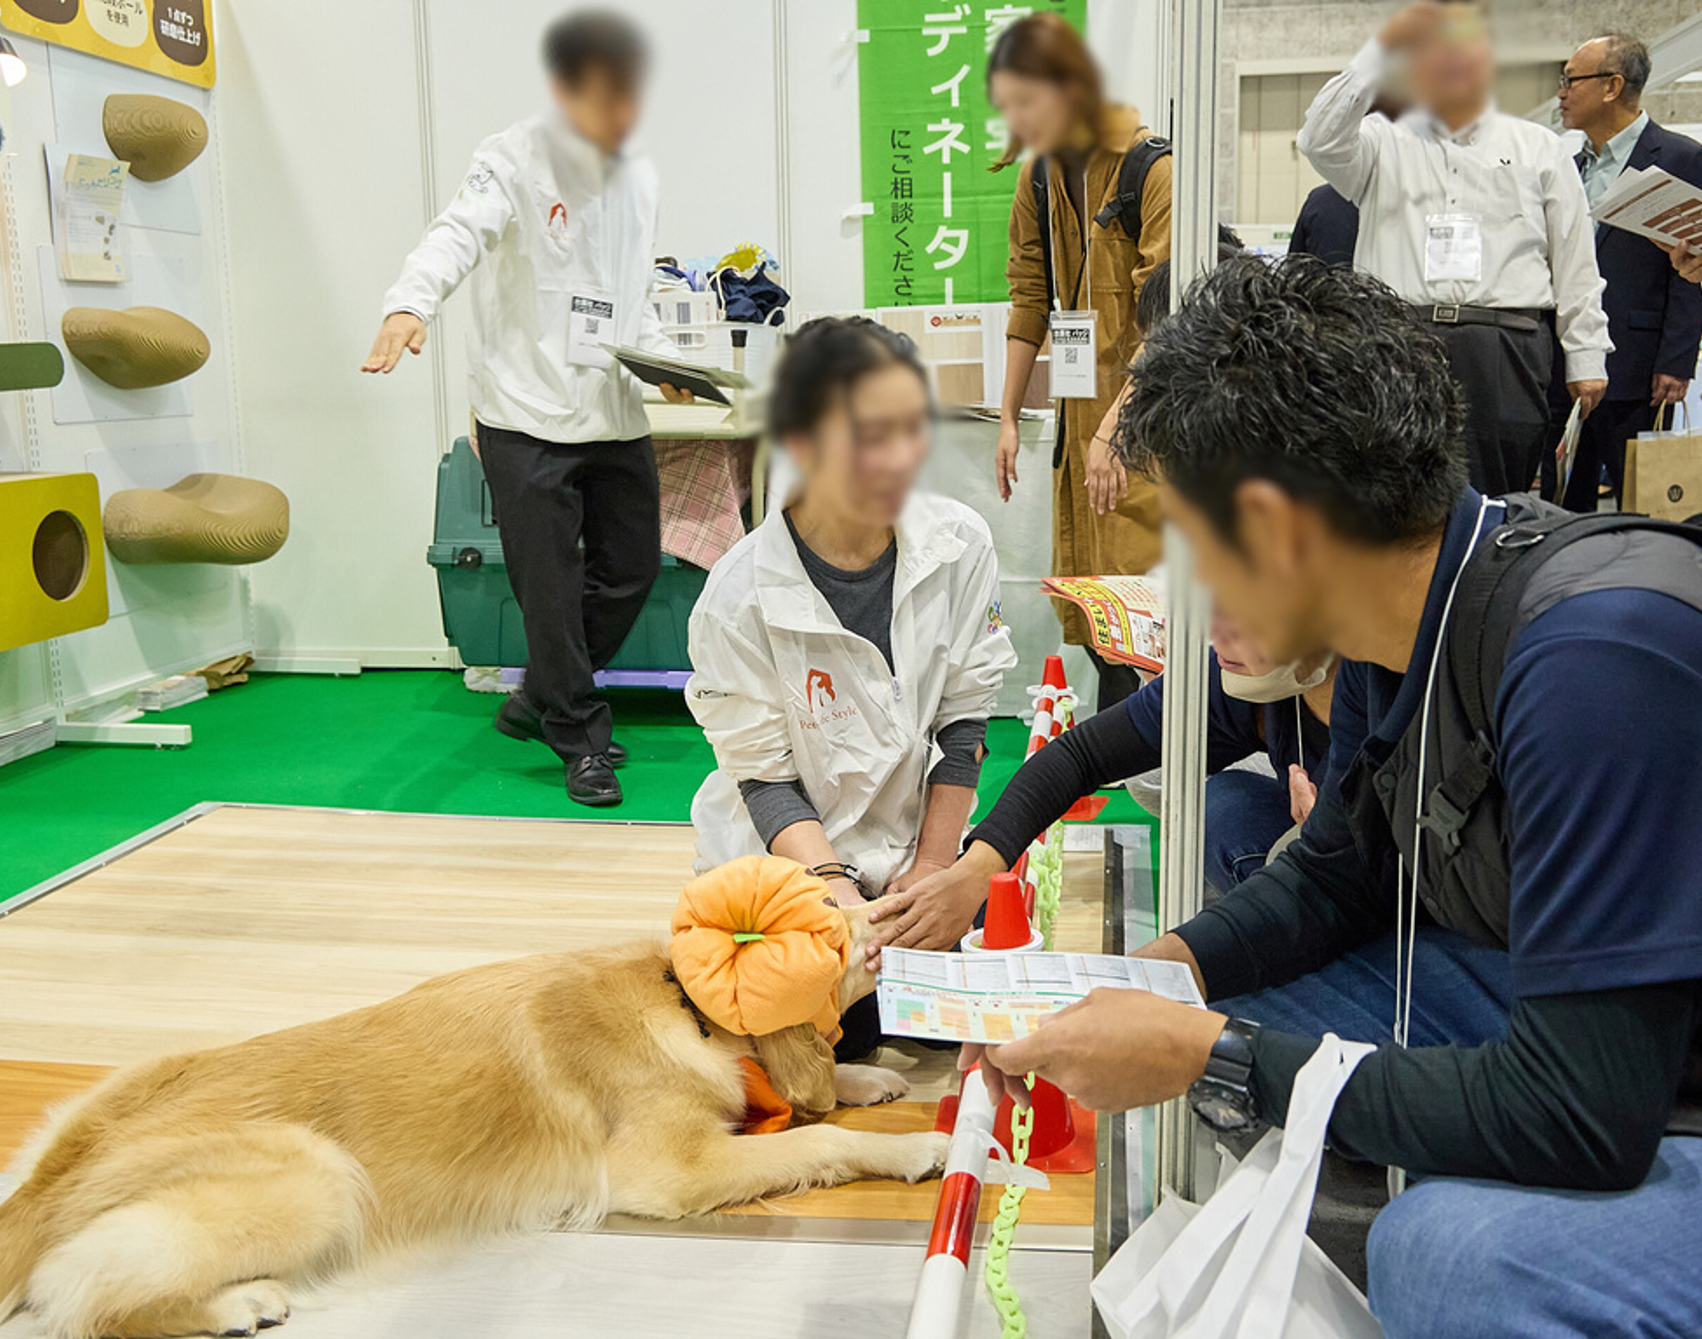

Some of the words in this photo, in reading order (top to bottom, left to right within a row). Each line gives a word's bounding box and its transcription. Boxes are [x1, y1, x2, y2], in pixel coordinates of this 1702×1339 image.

[890, 129, 914, 306] にご相談くださ
[921, 0, 972, 305] ディネーター
